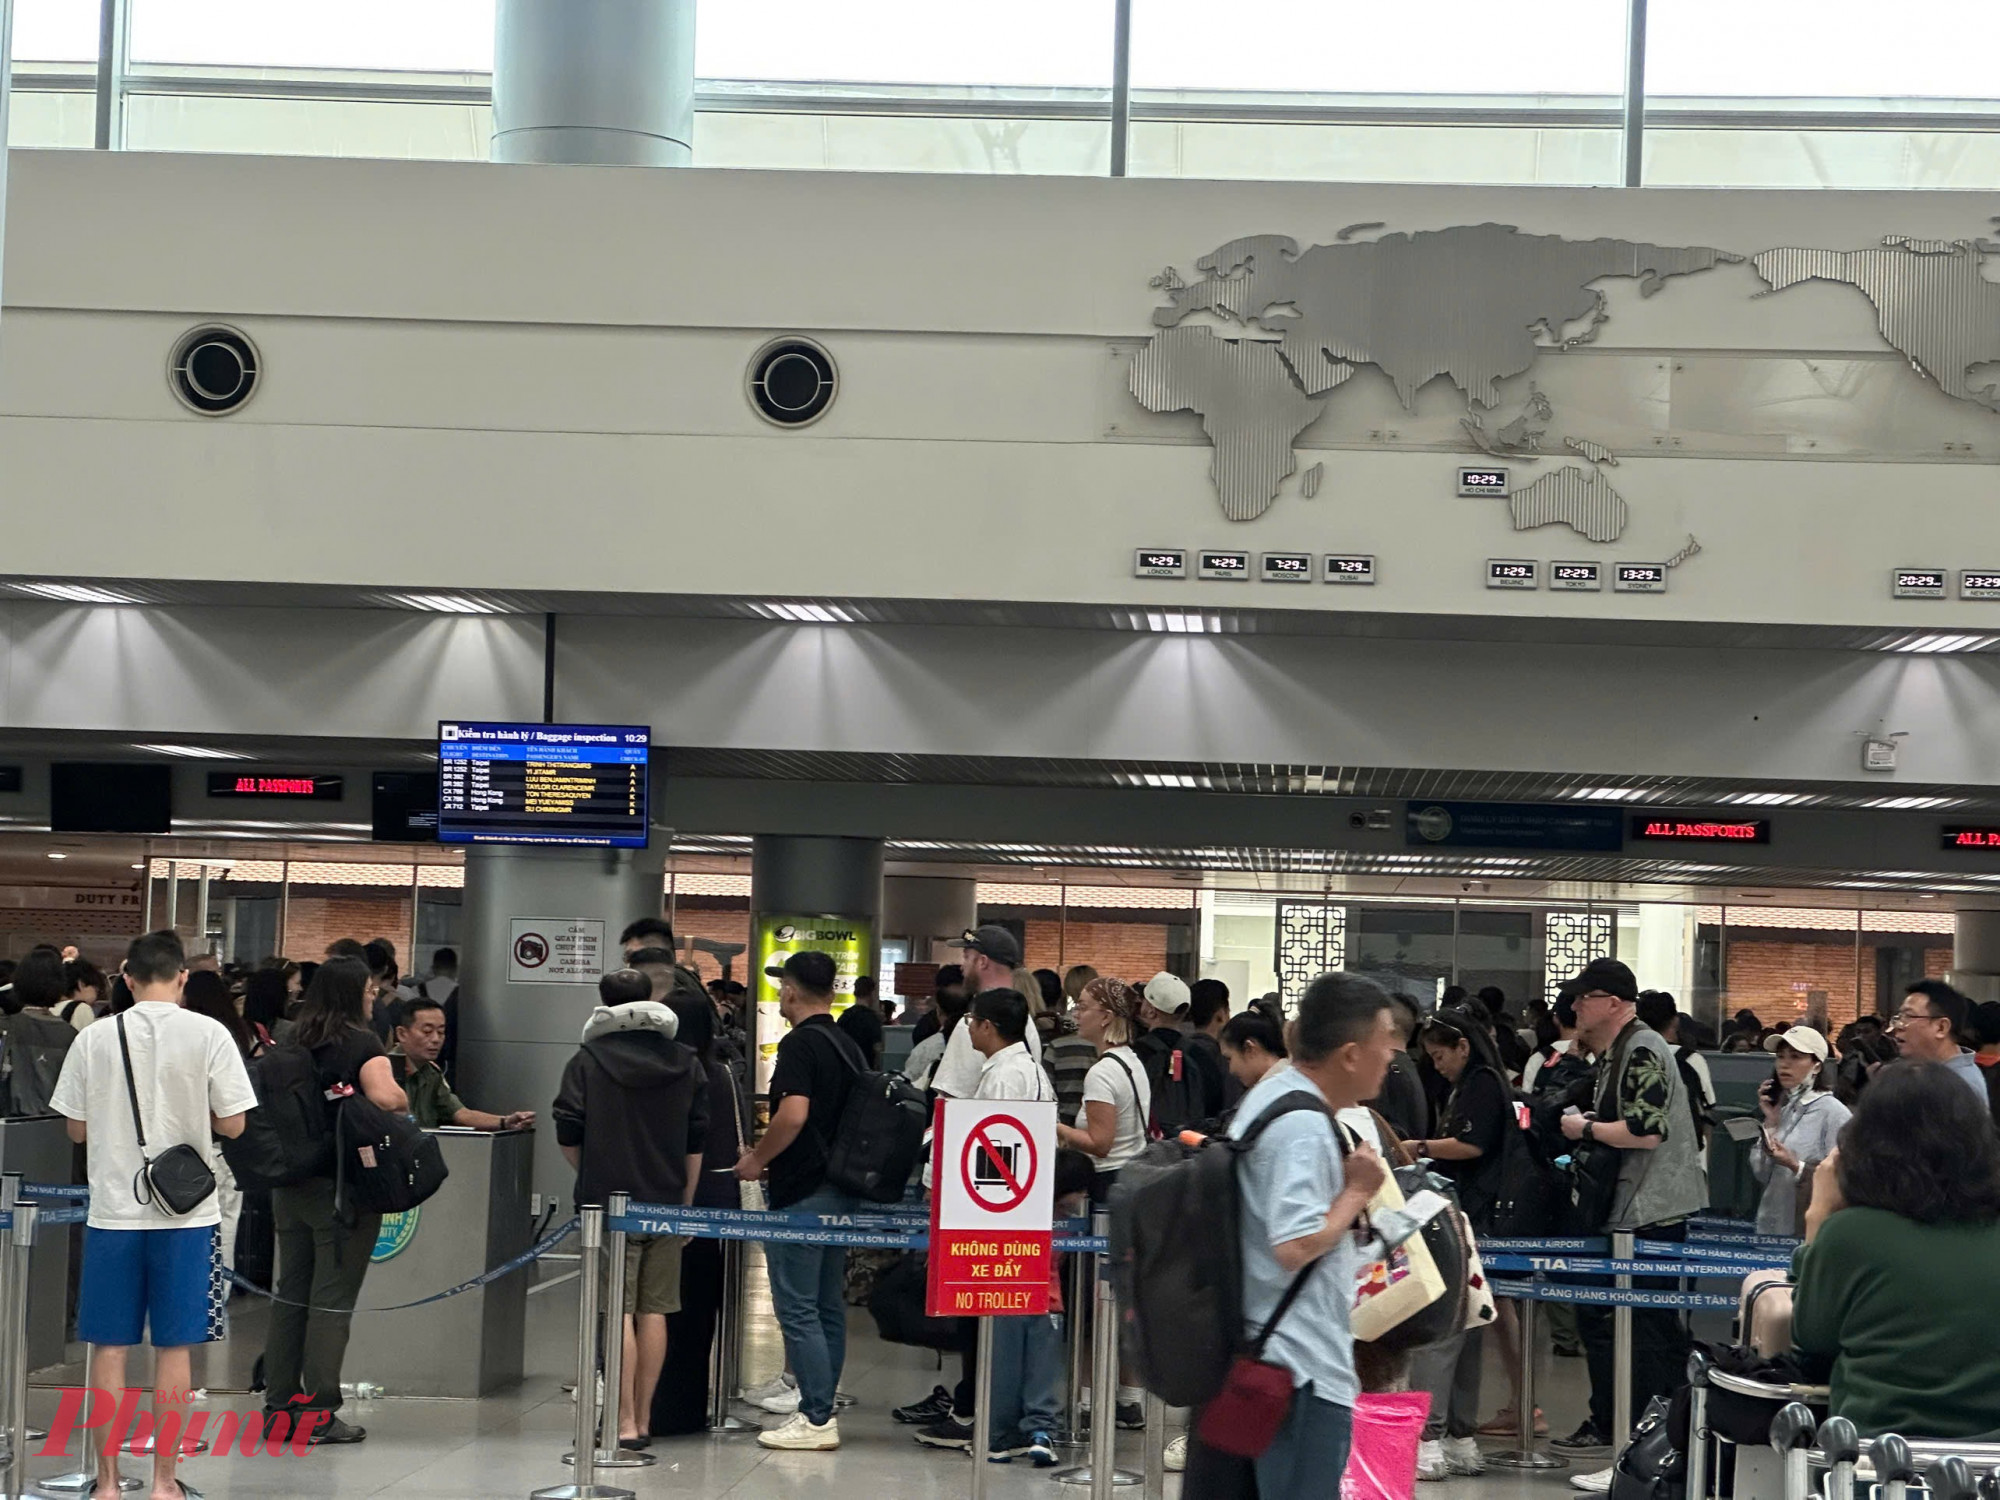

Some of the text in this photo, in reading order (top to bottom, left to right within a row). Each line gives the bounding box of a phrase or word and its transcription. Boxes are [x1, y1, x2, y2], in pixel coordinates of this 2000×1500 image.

[1468, 474, 1496, 484] 10:29
[1148, 556, 1174, 566] 4:29
[1212, 558, 1237, 568] 4:29
[1275, 560, 1300, 570] 7:29
[1338, 562, 1362, 572] 7:29
[1496, 567, 1526, 576] 11:29
[1559, 568, 1589, 578] 12:29
[1624, 570, 1654, 580] 13:29
[1899, 576, 1935, 586] 20:29
[1965, 578, 2000, 587] 23:29
[482, 731, 495, 739] tra
[497, 731, 519, 740] hành
[536, 732, 572, 742] Baggage
[574, 733, 617, 743] inspection
[625, 734, 647, 743] 10:29
[236, 778, 314, 794] ALL PASSPORTS
[1645, 823, 1755, 838] ALL PASSPORTS
[1956, 833, 1986, 844] ALL
[75, 894, 139, 905] DUTY FR
[40, 1211, 56, 1223] TIA
[382, 1213, 403, 1225] INH
[818, 1215, 853, 1226] TIA
[638, 1220, 673, 1233] TIA
[380, 1227, 398, 1238] RITY
[951, 1241, 998, 1256] KHÔNG
[1475, 1240, 1543, 1248] NTERNATIONAL
[1480, 1256, 1497, 1265] HẤT
[1529, 1258, 1568, 1270] TIA
[972, 1258, 1022, 1277] XE ĐẨY
[1610, 1262, 1630, 1270] TAN
[1632, 1263, 1653, 1272] SON
[1656, 1264, 1681, 1272] NHAT
[956, 1292, 1031, 1309] NO TROLLEY
